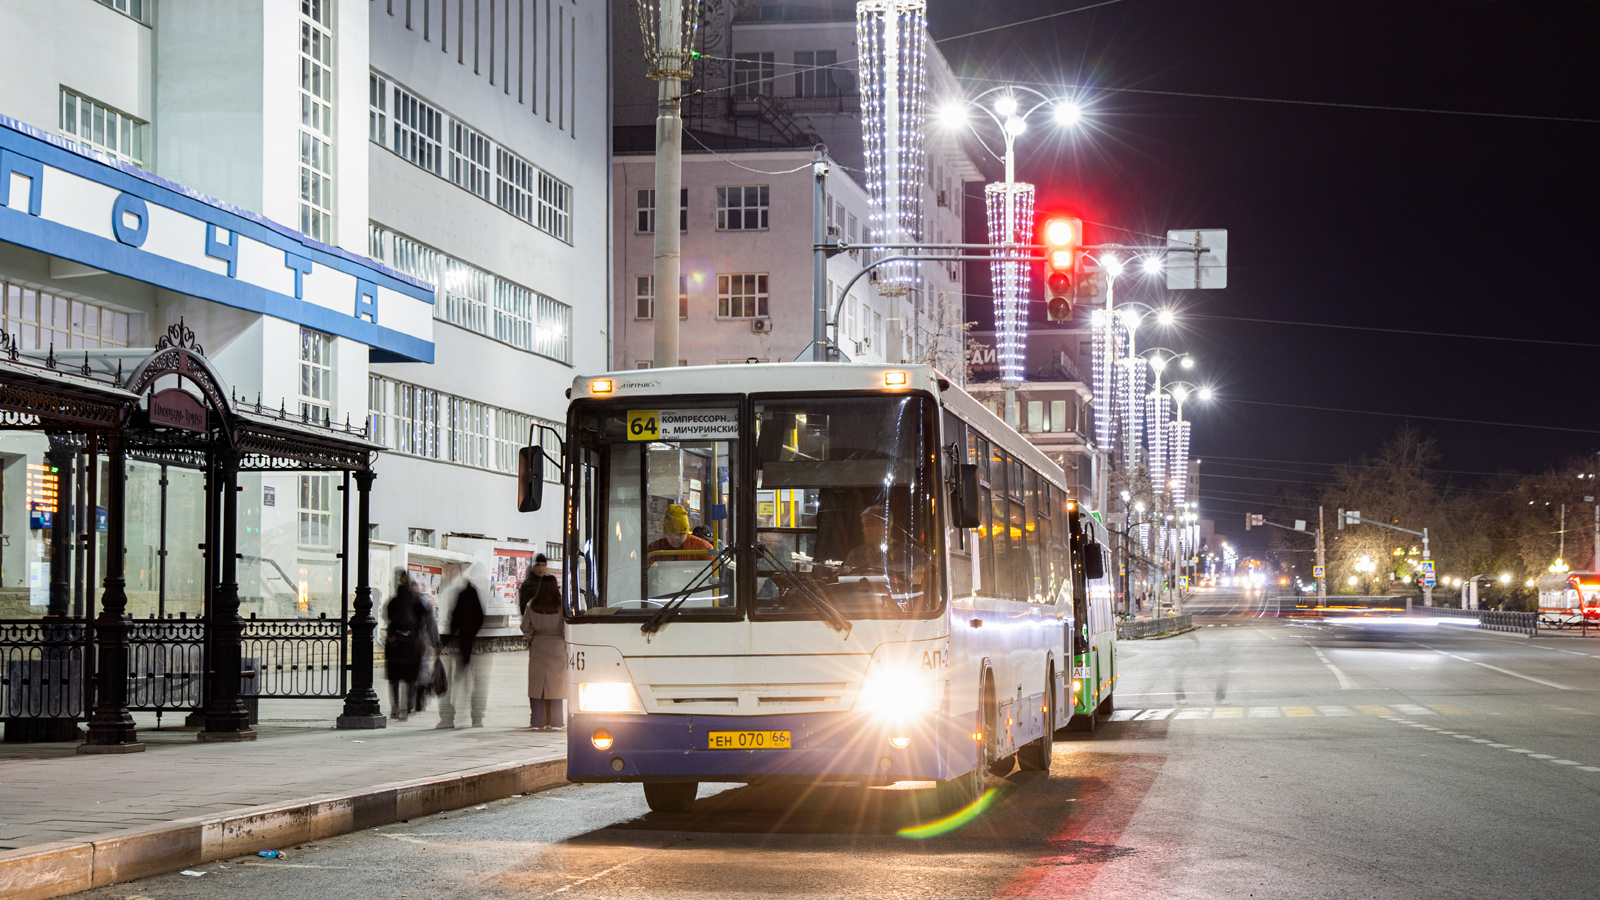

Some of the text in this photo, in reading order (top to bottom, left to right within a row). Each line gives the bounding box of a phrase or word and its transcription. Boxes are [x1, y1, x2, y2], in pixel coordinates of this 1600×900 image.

[0, 147, 379, 325] ПОЧТА
[630, 417, 657, 436] 64
[738, 733, 764, 746] 070
[772, 732, 786, 742] 66
